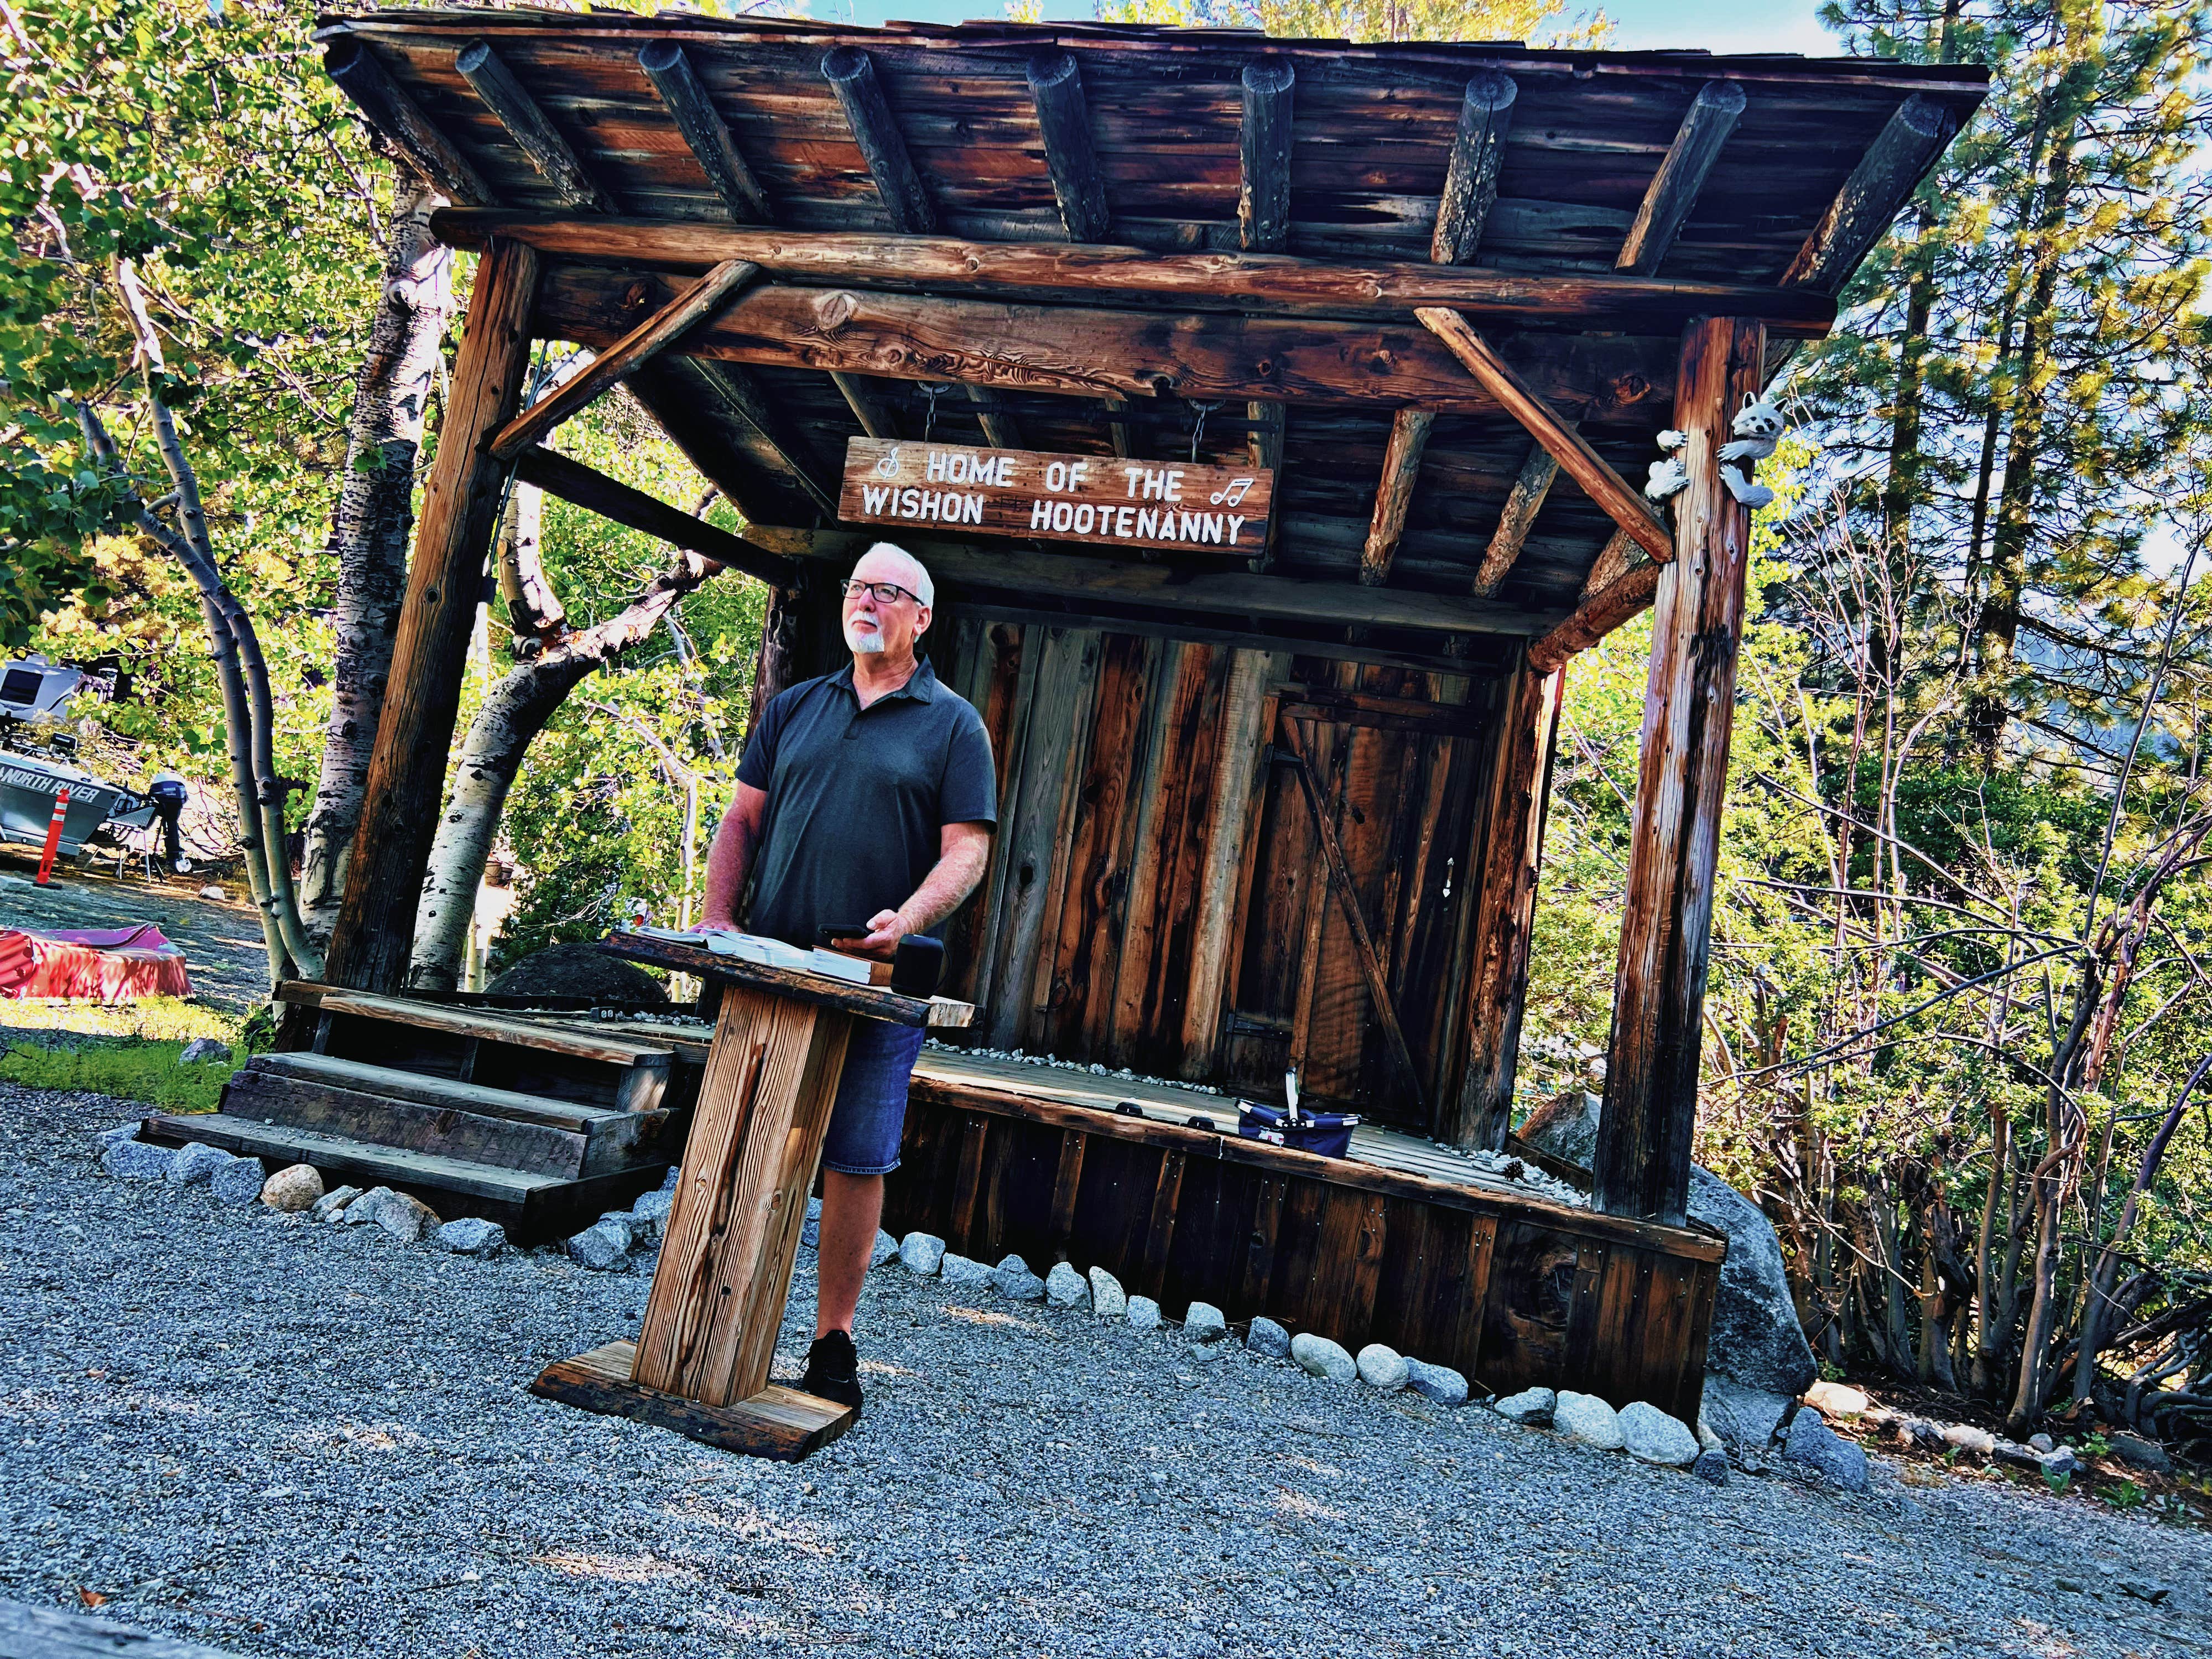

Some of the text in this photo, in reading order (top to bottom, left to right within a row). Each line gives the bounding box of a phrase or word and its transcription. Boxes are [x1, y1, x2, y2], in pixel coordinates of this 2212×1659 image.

[925, 451, 1185, 502] HOME OF THE
[861, 483, 1246, 545] WISHON HOOTENANNY
[1, 768, 54, 792] NORTH
